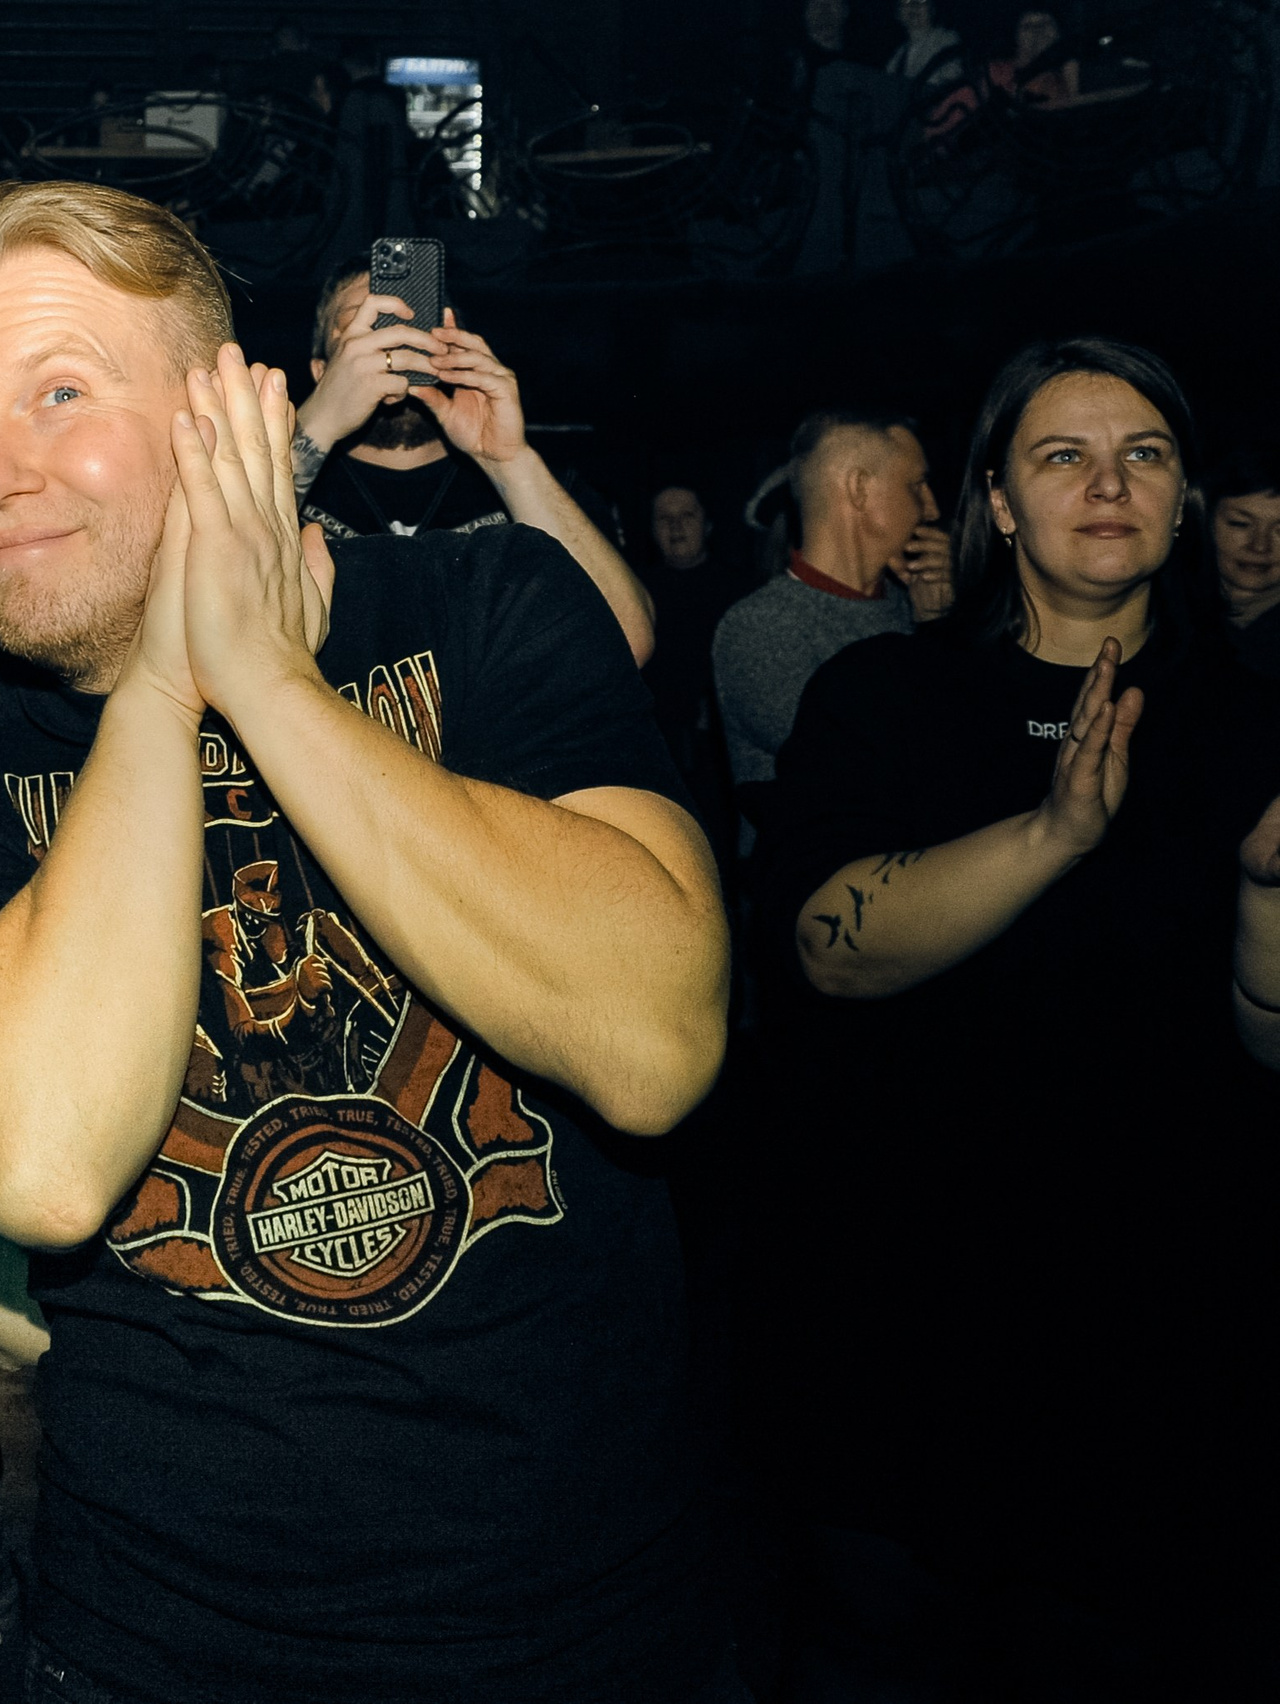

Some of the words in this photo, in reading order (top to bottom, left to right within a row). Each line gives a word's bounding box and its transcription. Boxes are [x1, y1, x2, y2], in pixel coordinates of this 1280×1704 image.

[240, 1117, 288, 1162] TESTED,
[336, 1109, 379, 1126] TRUE,
[288, 1160, 380, 1201] MOTOR
[256, 1181, 426, 1246] HARLEY-DAVIDSON
[304, 1226, 393, 1270] CYCLES
